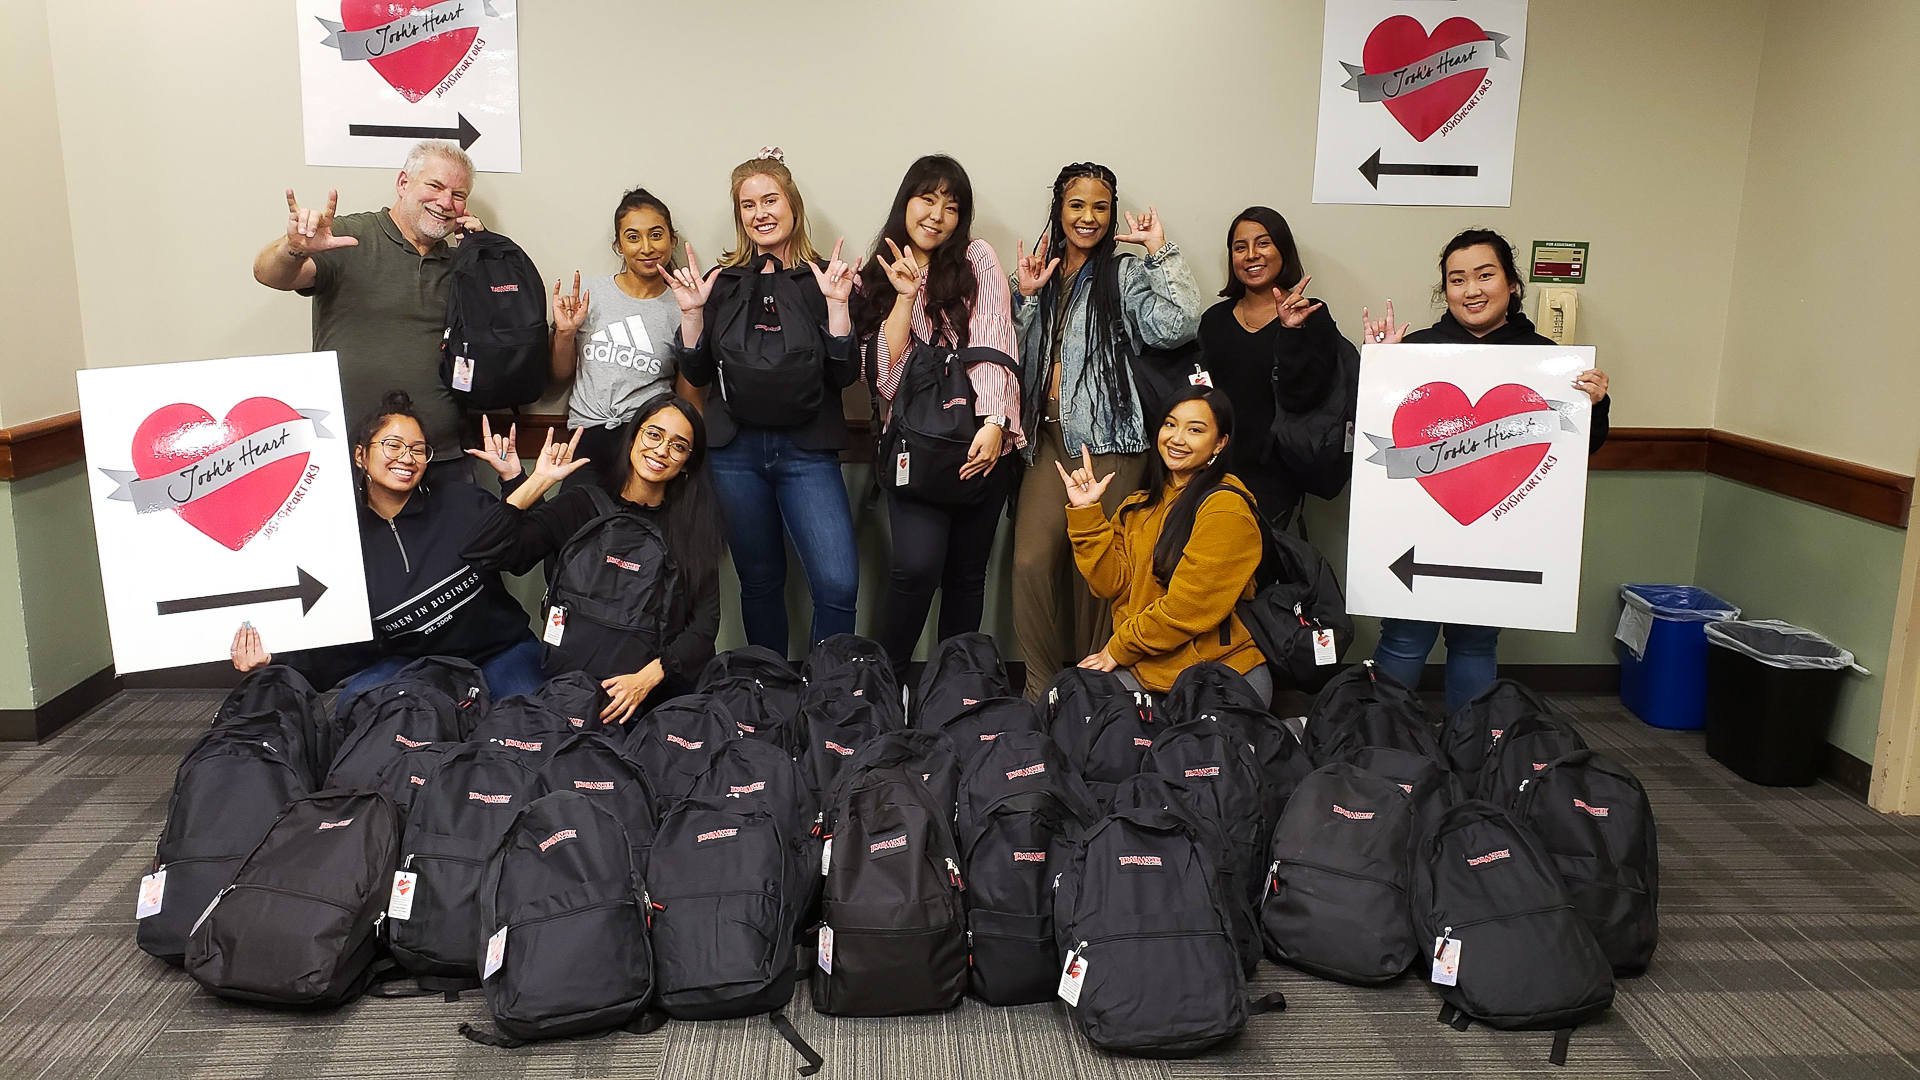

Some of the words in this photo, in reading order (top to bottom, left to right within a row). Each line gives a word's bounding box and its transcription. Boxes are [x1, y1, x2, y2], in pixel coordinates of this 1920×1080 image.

[365, 24, 419, 56] Josh's
[422, 3, 465, 32] Heart
[1382, 65, 1434, 98] Josh's
[1437, 45, 1478, 74] Heart
[582, 341, 662, 375] adidas
[167, 458, 235, 503] Josh's
[238, 428, 290, 466] Heart
[1416, 439, 1480, 474] Josh's
[1483, 417, 1536, 449] Het
[381, 614, 414, 632] OMEN
[414, 605, 429, 618] IN
[430, 572, 479, 609] BUSINESS
[437, 613, 454, 629] 2006
